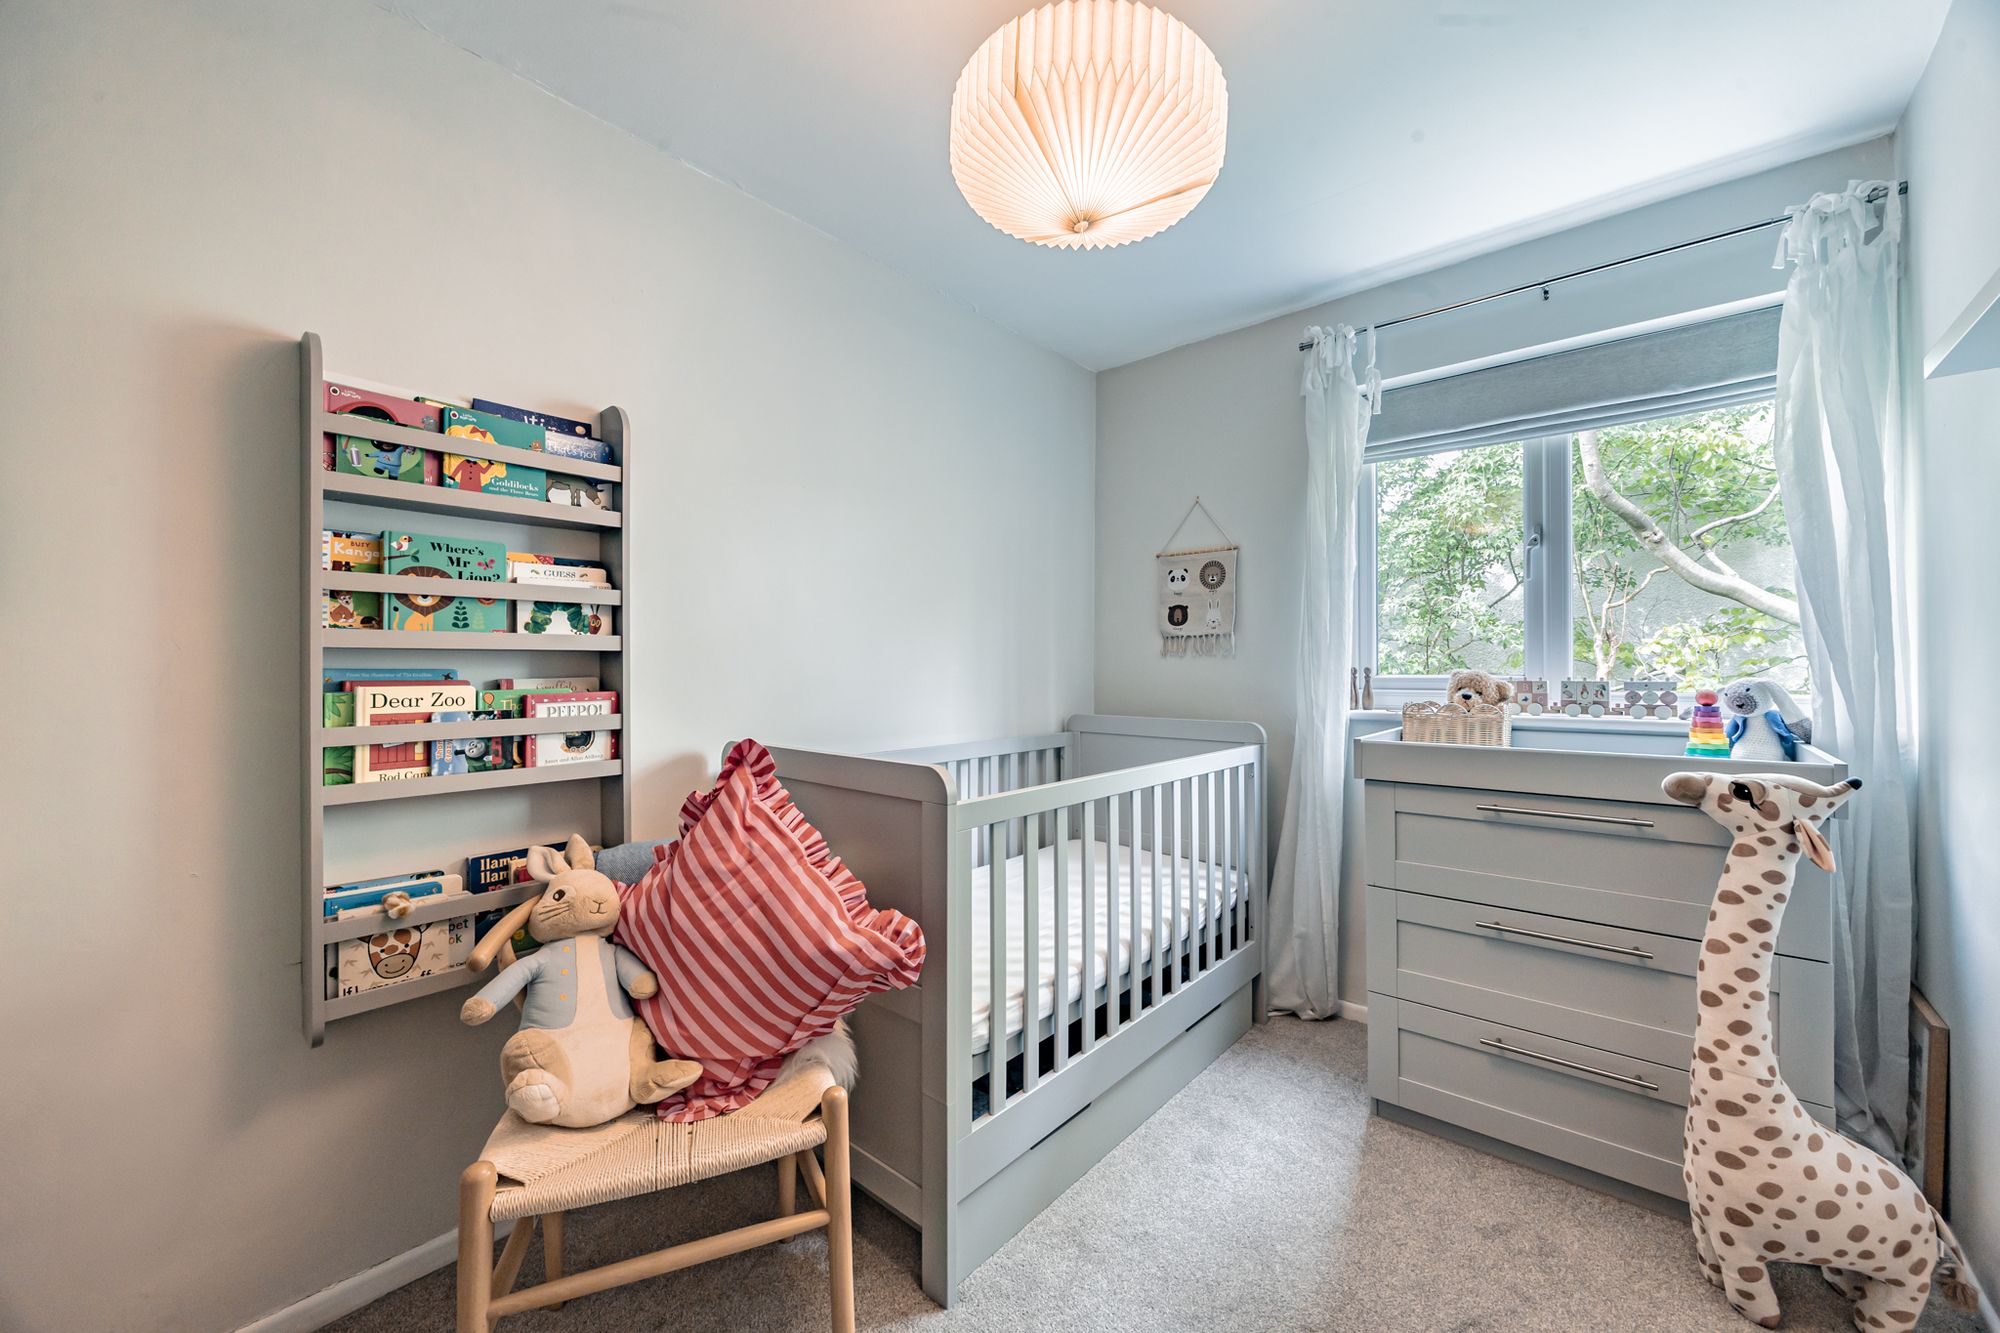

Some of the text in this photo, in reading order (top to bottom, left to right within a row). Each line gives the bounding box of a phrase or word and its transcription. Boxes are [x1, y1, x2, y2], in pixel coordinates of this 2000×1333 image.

[491, 478, 539, 492] Goldilocks
[350, 540, 371, 548] BUSY
[429, 541, 484, 556] Where's
[447, 556, 471, 568] Mr
[458, 570, 501, 582] Lion?
[543, 568, 577, 579] GUESS
[370, 691, 465, 708] Dear Zoo
[547, 703, 603, 717] PEEPO!
[379, 772, 400, 782] Rod
